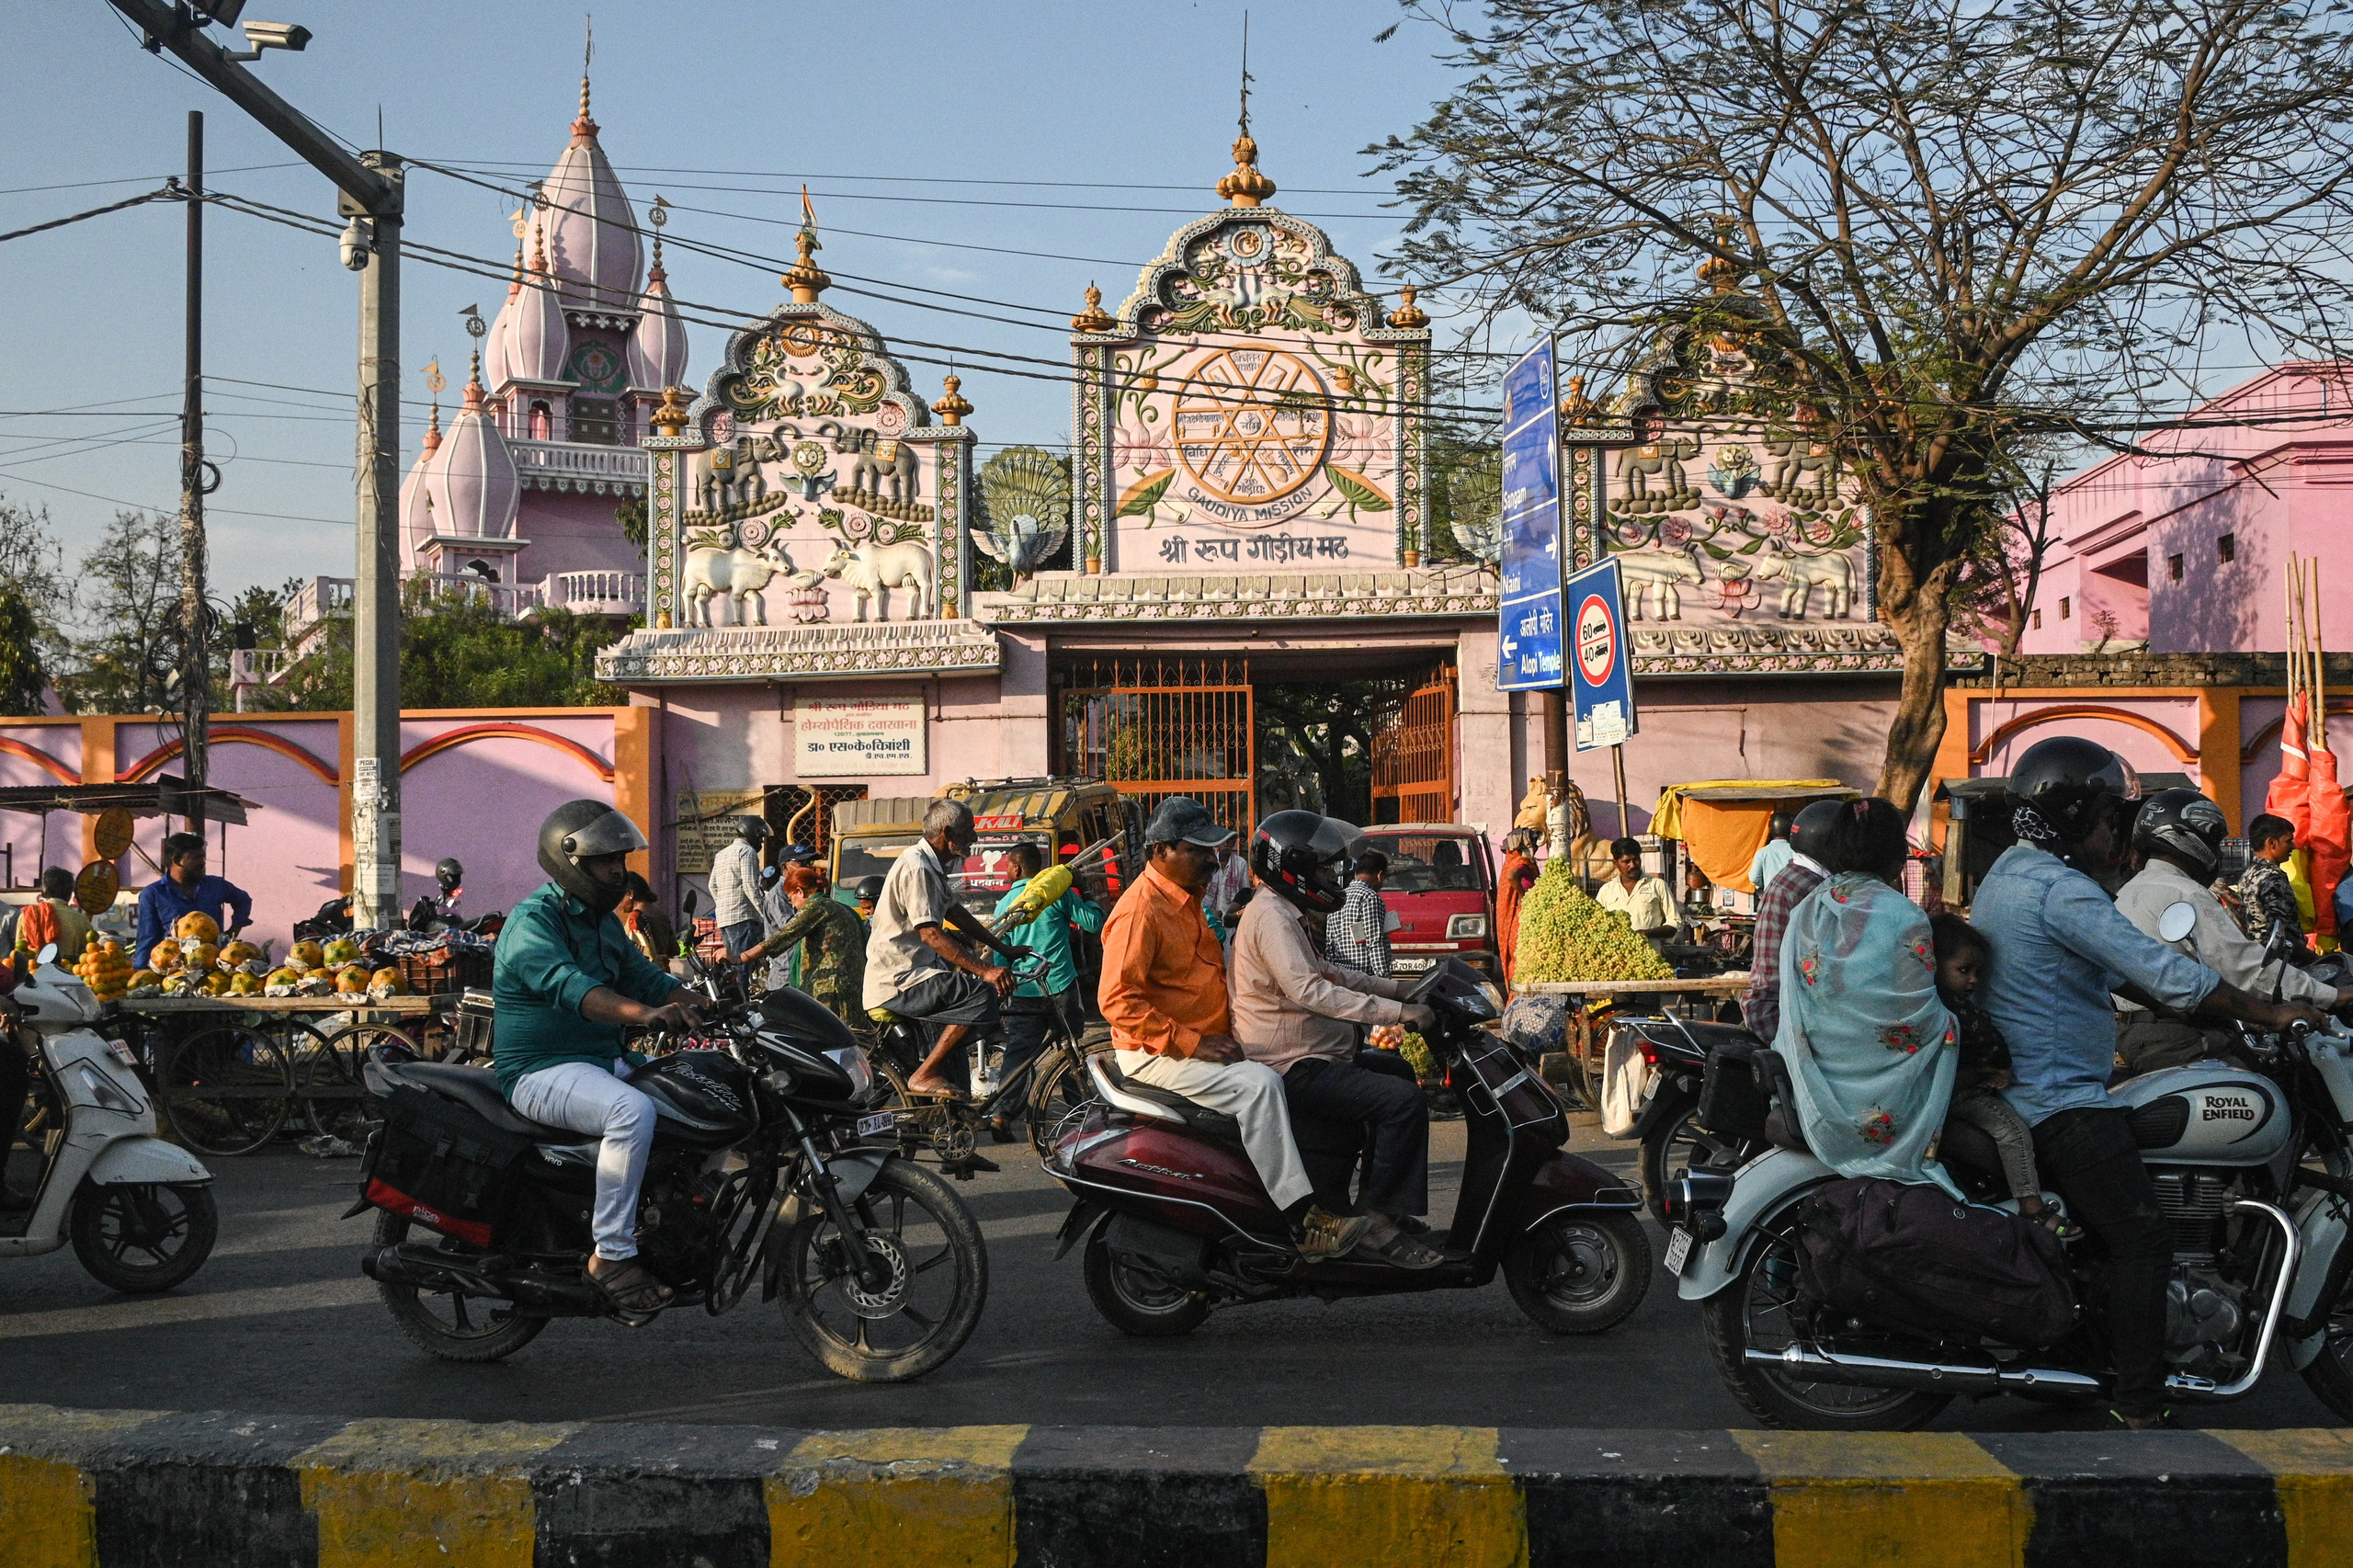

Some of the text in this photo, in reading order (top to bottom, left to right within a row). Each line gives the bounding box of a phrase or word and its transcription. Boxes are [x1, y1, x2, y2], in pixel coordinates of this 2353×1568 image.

[1188, 486, 1313, 521] GAUDIYA MISSION
[1504, 486, 1527, 511] Sangam
[1159, 535, 1188, 563] श्री
[1316, 536, 1348, 560] मठ
[1502, 572, 1521, 595] Naini
[1520, 608, 1538, 637] अलोपी
[1583, 622, 1593, 641] 60
[1521, 647, 1561, 676] Alopi Temple
[1584, 646, 1595, 664] 40
[808, 701, 822, 711] श्री
[892, 702, 910, 710] मठ
[868, 720, 917, 730] दवाखाना
[977, 816, 1020, 829] KALI
[2205, 1096, 2248, 1108] ROYAL
[2202, 1109, 2255, 1121] ENFIELD
